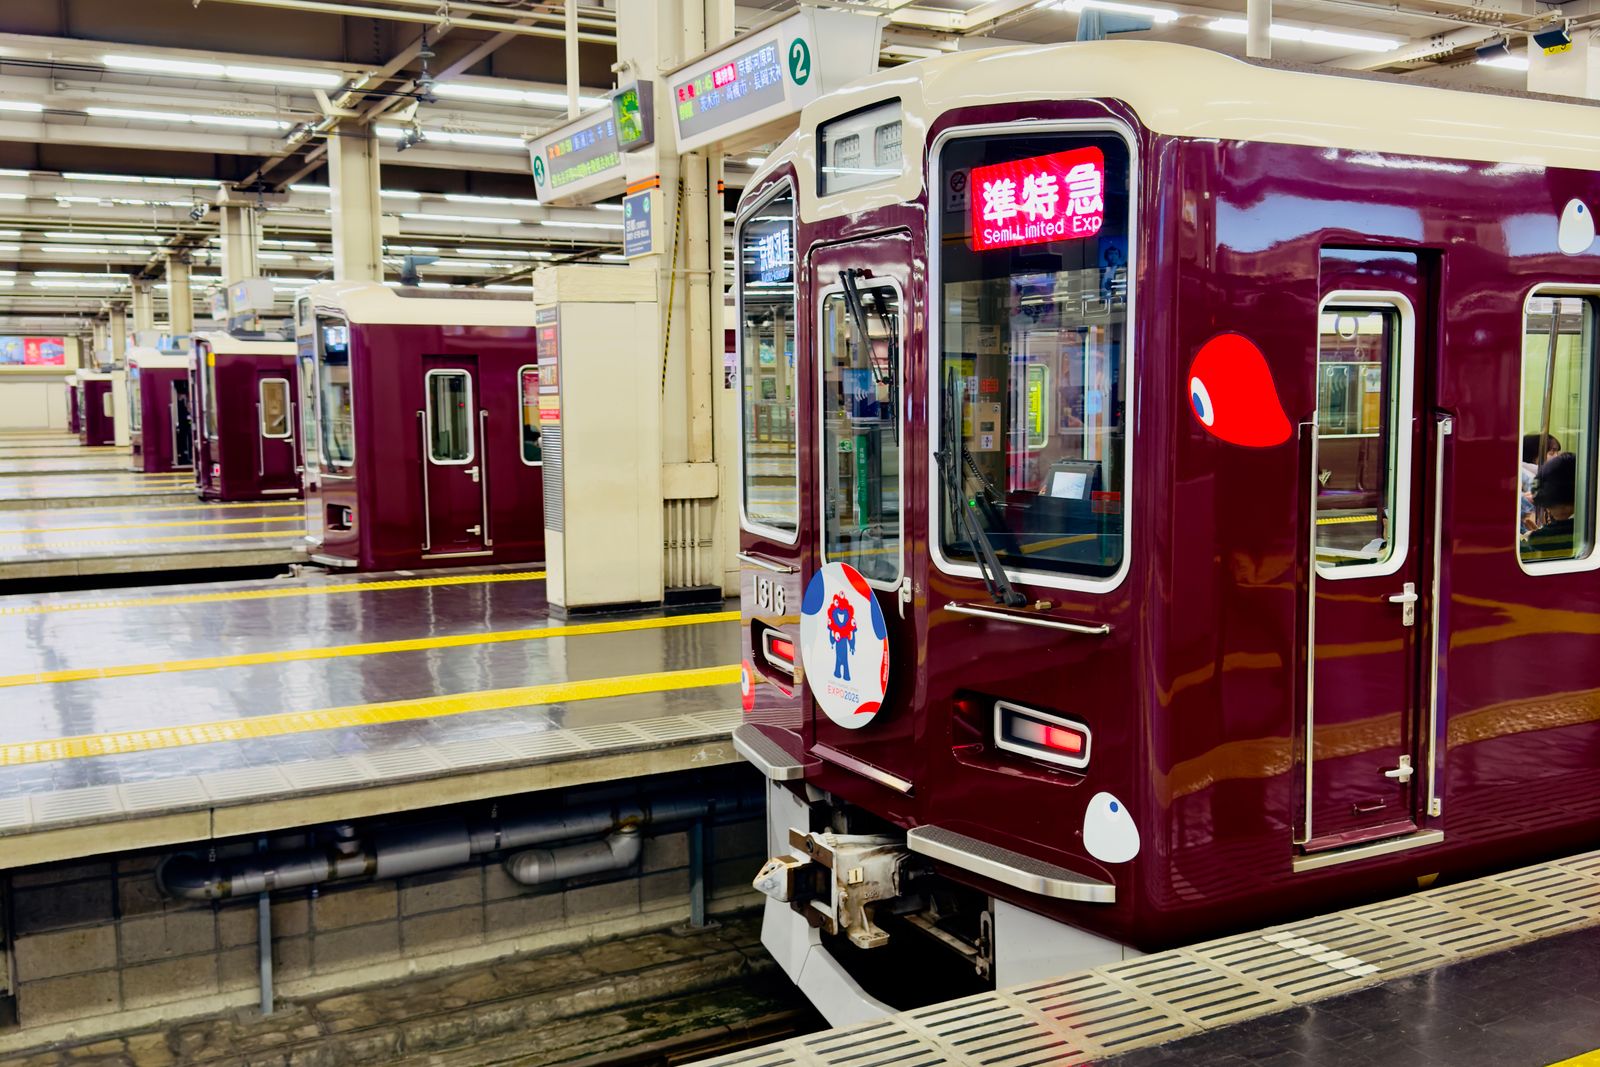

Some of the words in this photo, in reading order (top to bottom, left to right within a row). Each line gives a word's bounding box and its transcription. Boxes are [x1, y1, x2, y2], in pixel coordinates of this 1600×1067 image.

[793, 44, 807, 79] 2
[983, 163, 1103, 226] 準特急
